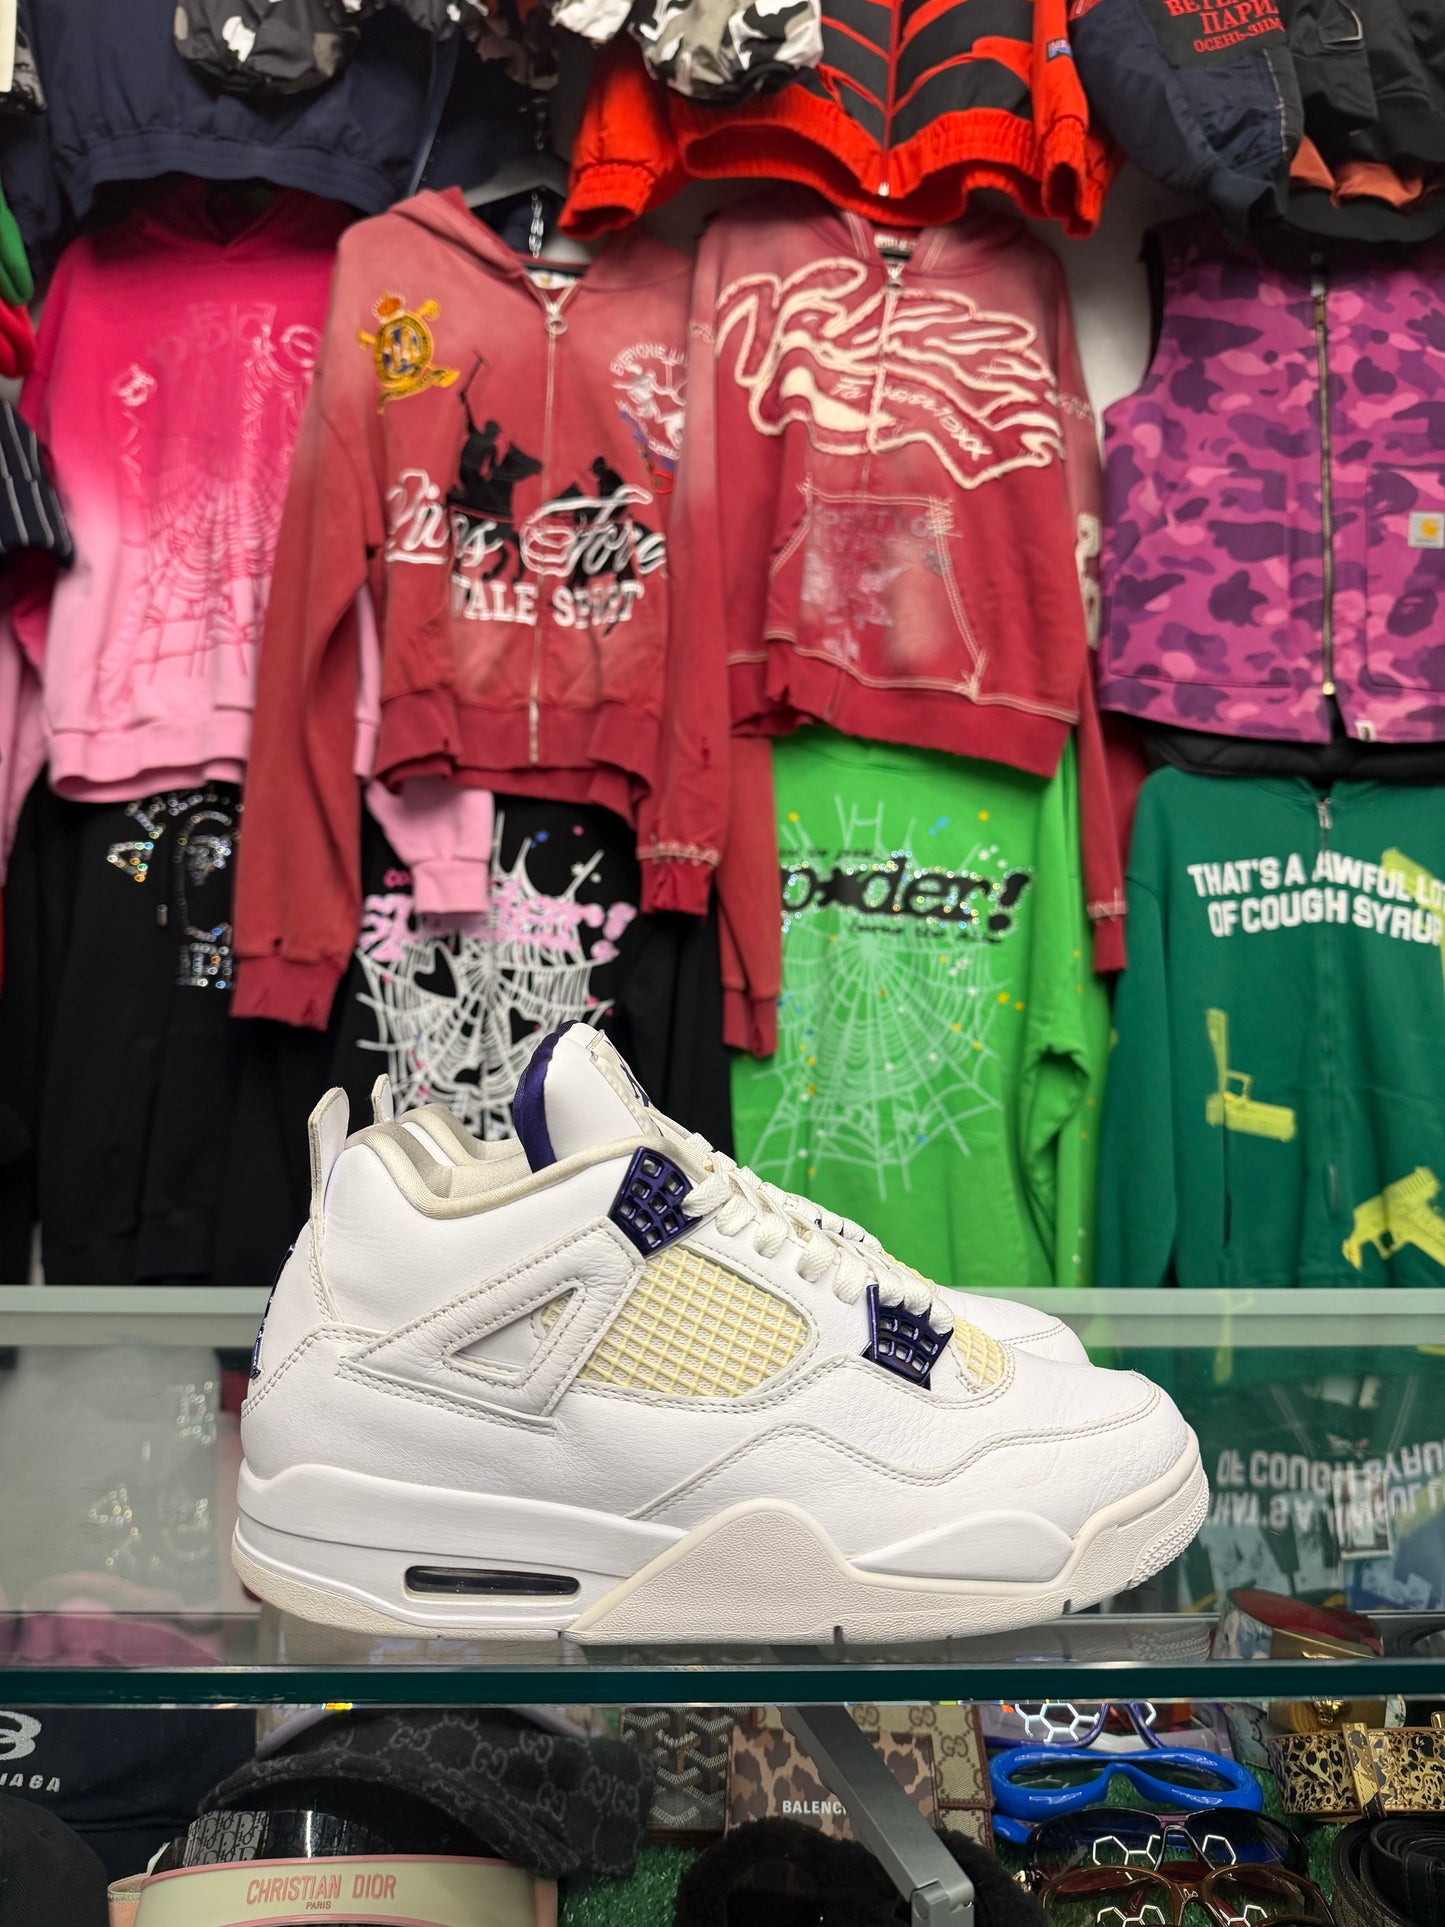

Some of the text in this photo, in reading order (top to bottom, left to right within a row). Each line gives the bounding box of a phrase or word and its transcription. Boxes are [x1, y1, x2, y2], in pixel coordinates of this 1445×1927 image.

[1187, 856, 1281, 897] THAT'S
[1284, 852, 1306, 886] A
[1312, 850, 1412, 902] AWFUL
[1207, 900, 1239, 937] OF
[1241, 887, 1348, 933] COUGH
[246, 1873, 397, 1905] CHRISTIAN DIOR
[306, 1901, 332, 1910] PARIS
